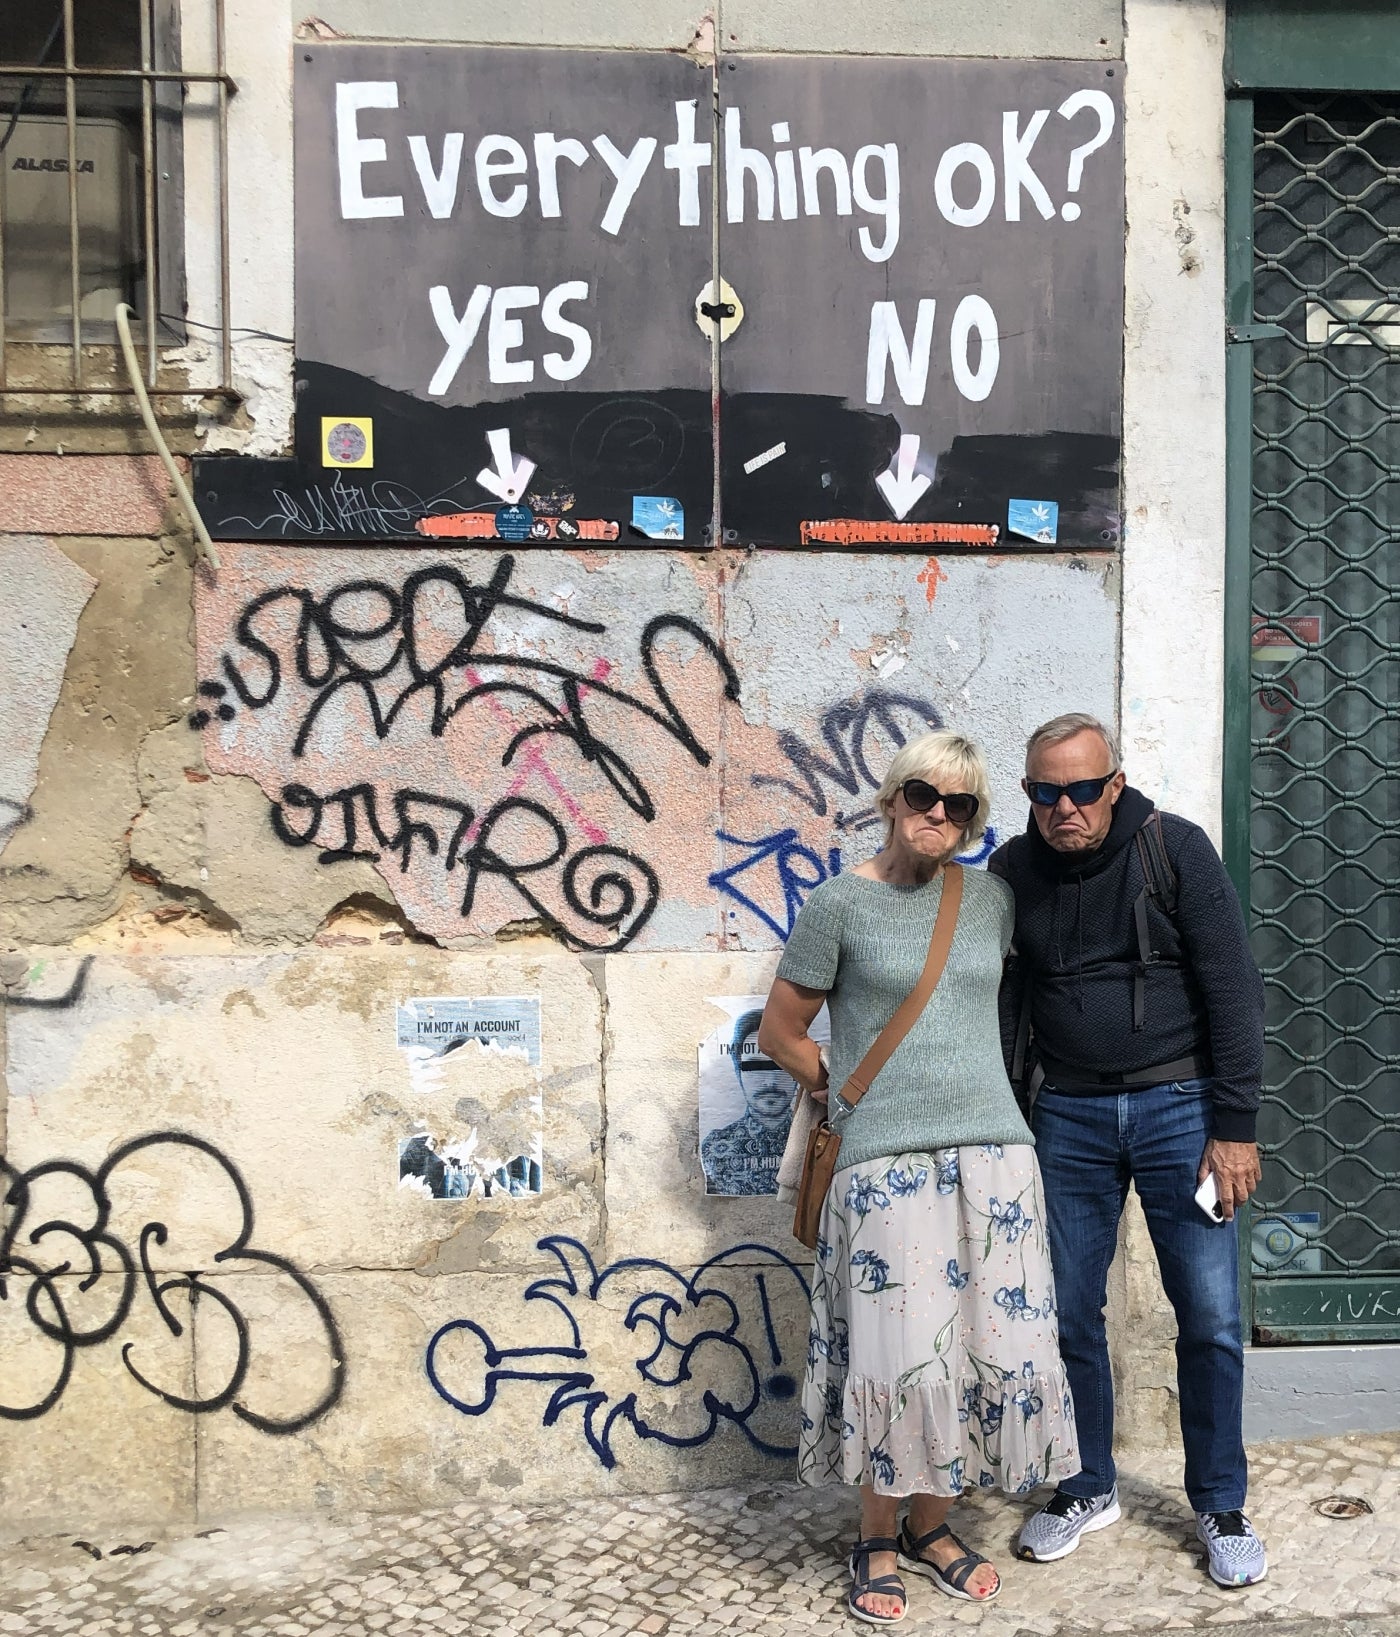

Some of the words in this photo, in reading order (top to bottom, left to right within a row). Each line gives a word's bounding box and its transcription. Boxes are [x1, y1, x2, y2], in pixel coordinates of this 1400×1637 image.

[335, 81, 900, 263] Everything
[428, 280, 591, 396] YES
[866, 295, 1000, 406] NO
[417, 1021, 433, 1034] I'M
[434, 1021, 454, 1033] NOT
[455, 1021, 469, 1033] AN
[473, 1020, 521, 1033] ACCOUNT
